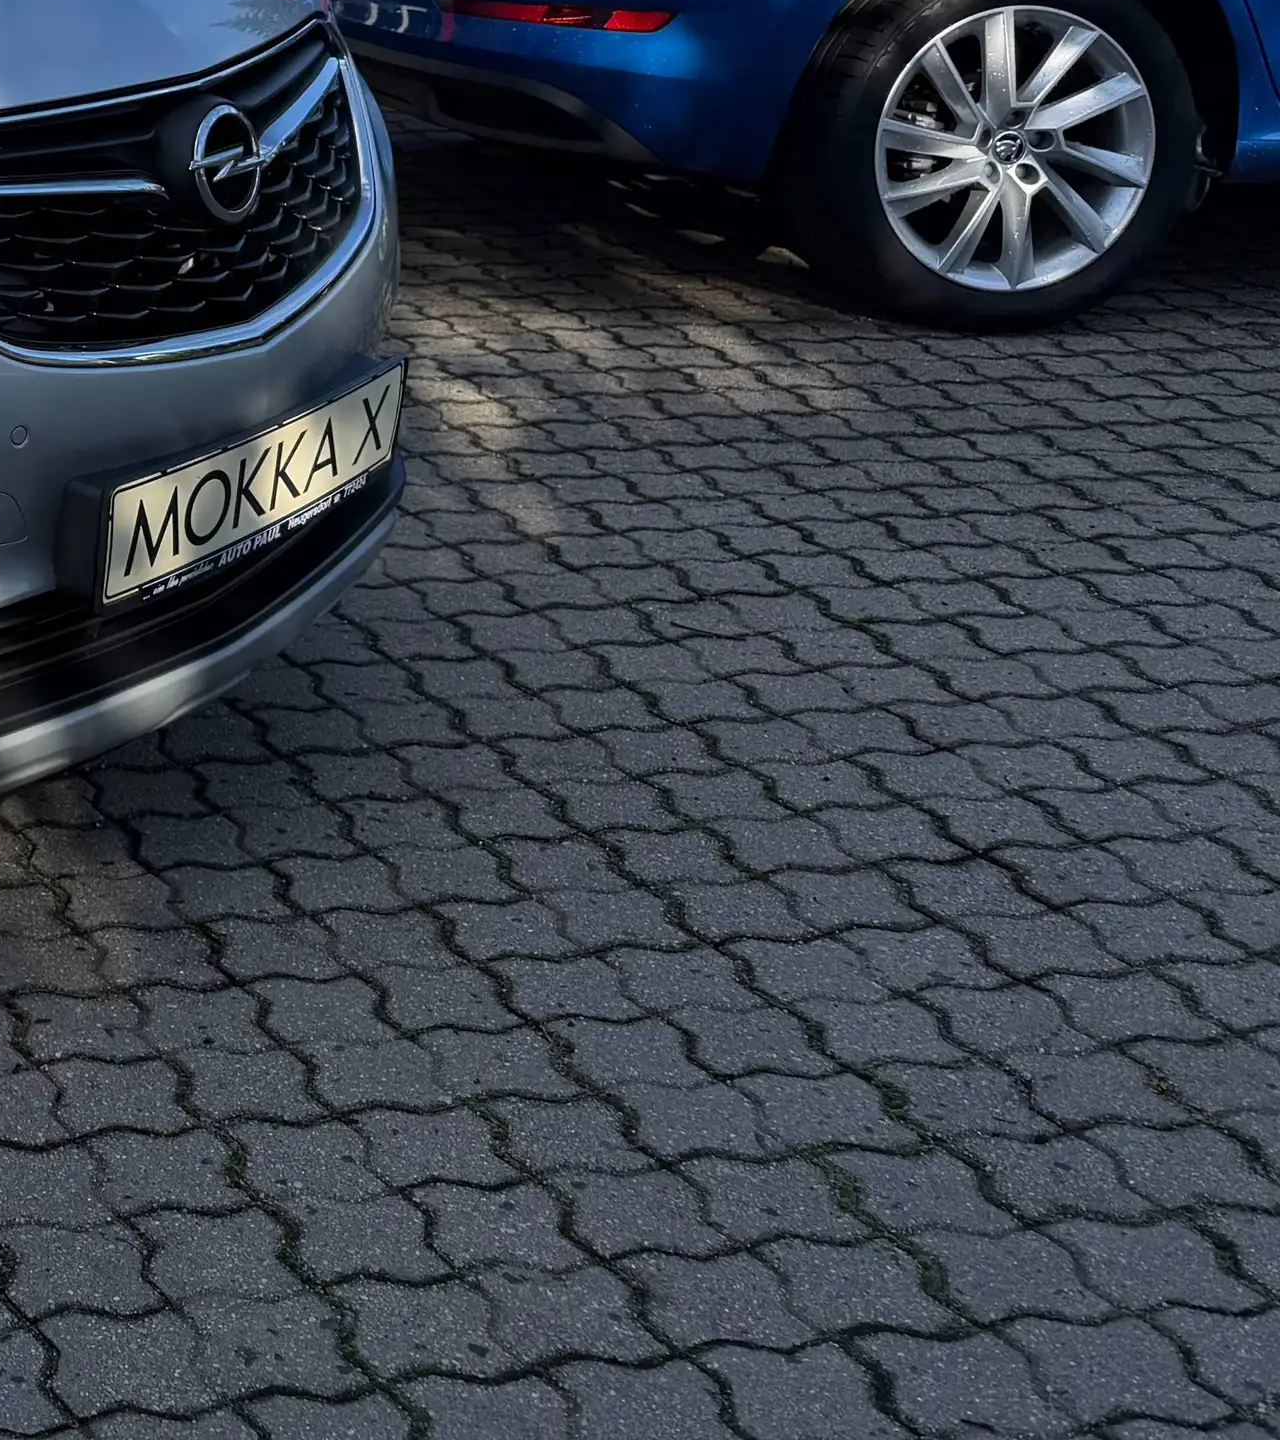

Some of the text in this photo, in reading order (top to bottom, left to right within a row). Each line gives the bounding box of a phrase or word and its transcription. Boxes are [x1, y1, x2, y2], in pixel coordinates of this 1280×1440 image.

[123, 384, 391, 578] MOKKA X
[218, 539, 252, 568] AUTO
[252, 526, 281, 551] PAUL
